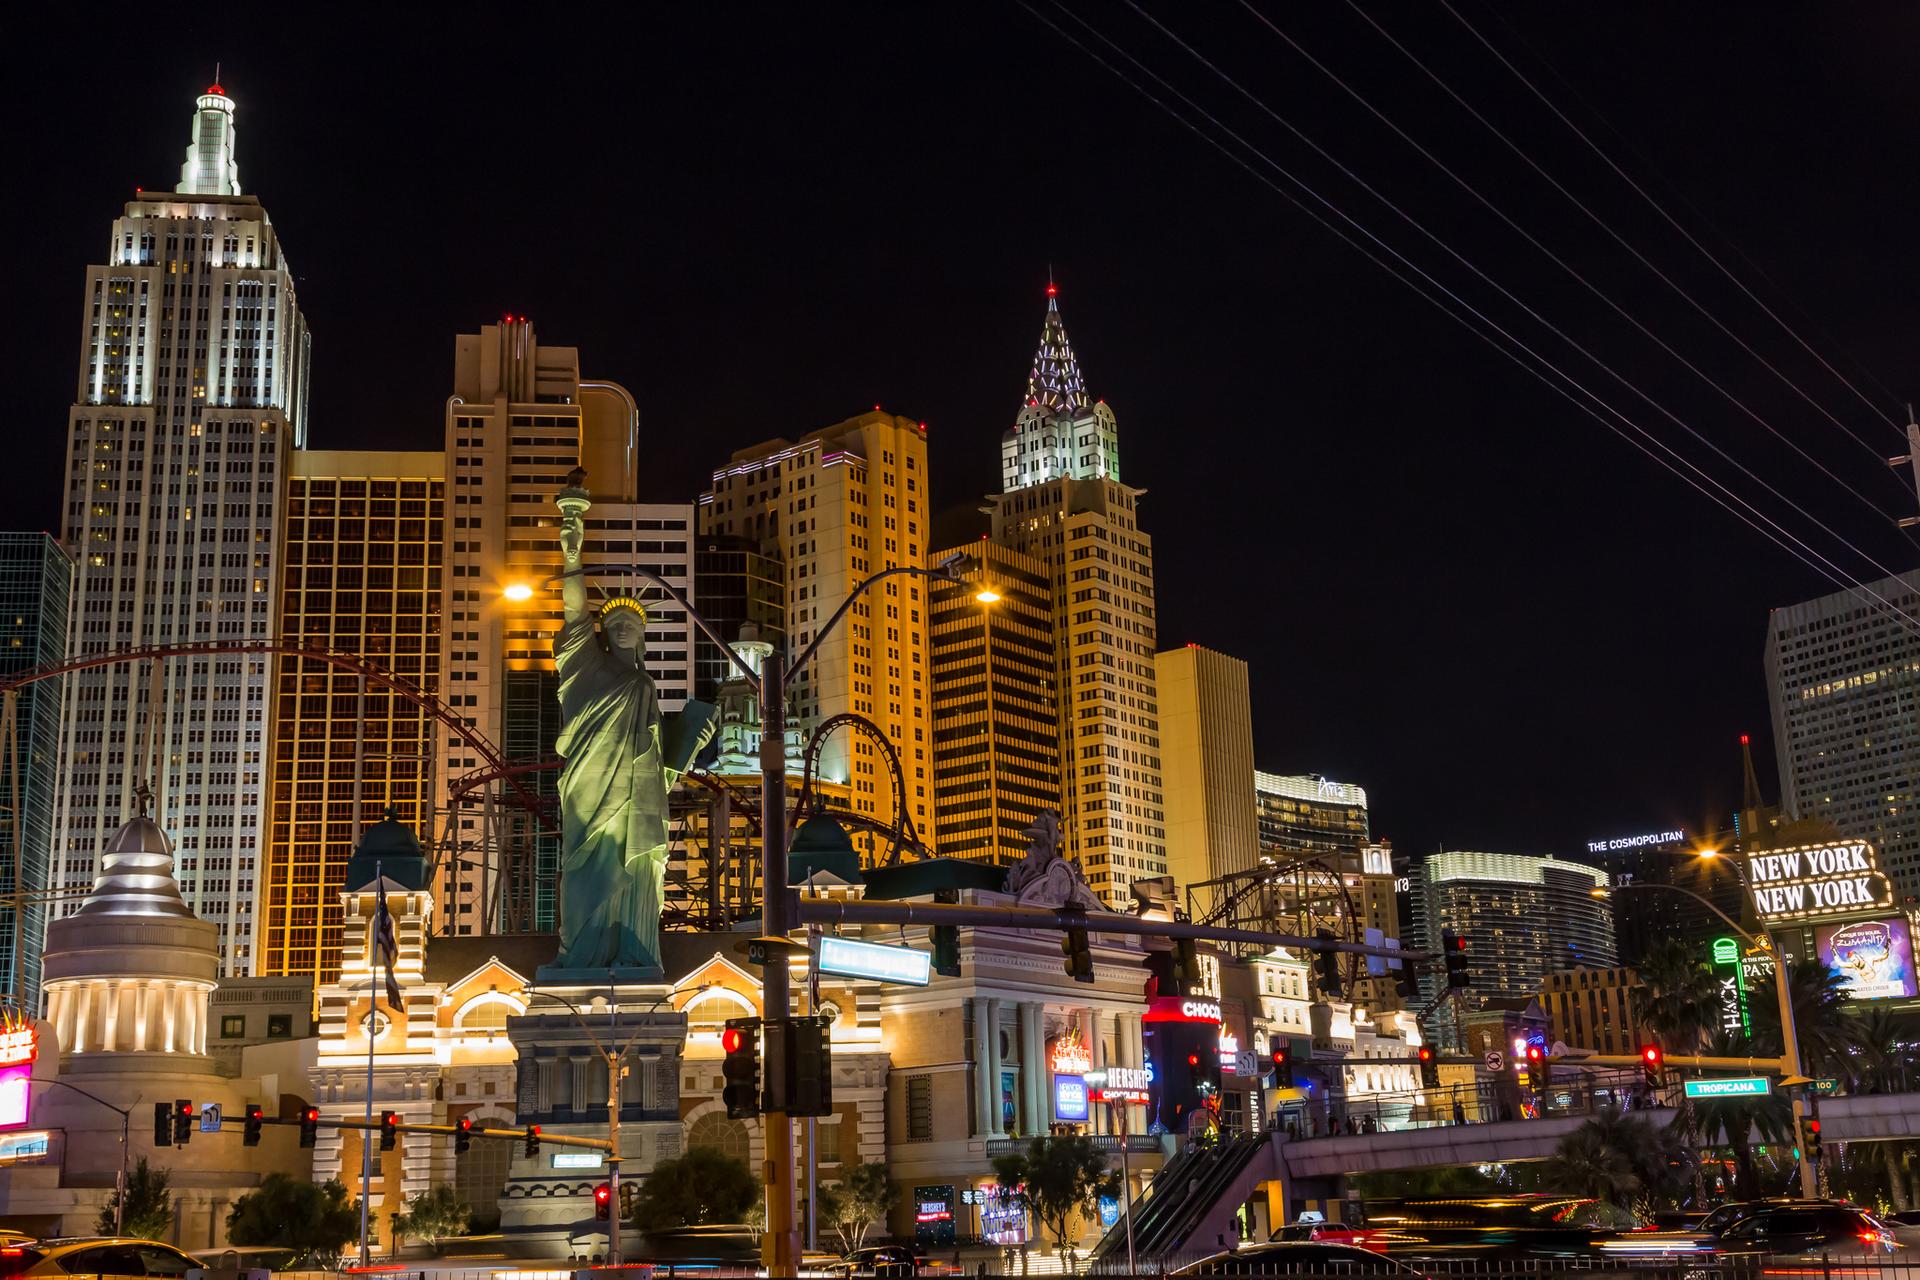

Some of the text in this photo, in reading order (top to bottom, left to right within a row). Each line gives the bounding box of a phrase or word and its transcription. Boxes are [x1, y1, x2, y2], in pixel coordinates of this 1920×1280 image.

[1588, 830, 1684, 853] THE COSMOPOLITAN
[1750, 844, 1870, 882] NEW YORK
[1754, 877, 1874, 914] NEW YORK
[1837, 934, 1887, 947] ZUMANITY
[1697, 1081, 1756, 1093] TROPICANA
[1816, 1081, 1832, 1089] 100
